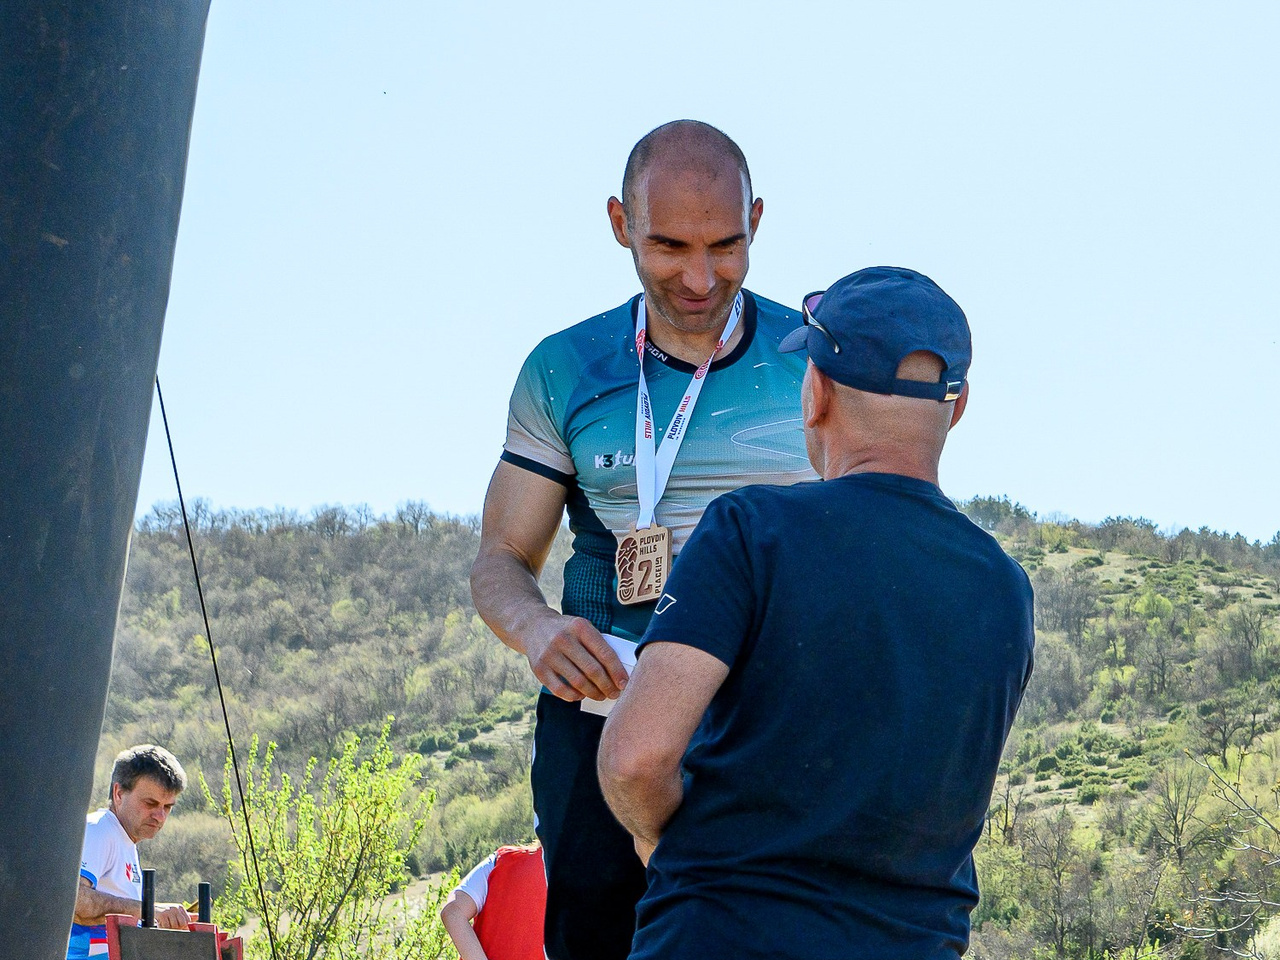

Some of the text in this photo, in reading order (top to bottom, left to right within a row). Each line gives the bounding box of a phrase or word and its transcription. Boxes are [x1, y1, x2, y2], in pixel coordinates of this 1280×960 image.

[667, 413, 684, 440] PLOVDIV
[640, 533, 666, 546] PLOVDIV
[640, 544, 657, 556] HILLS
[637, 559, 653, 596] 2
